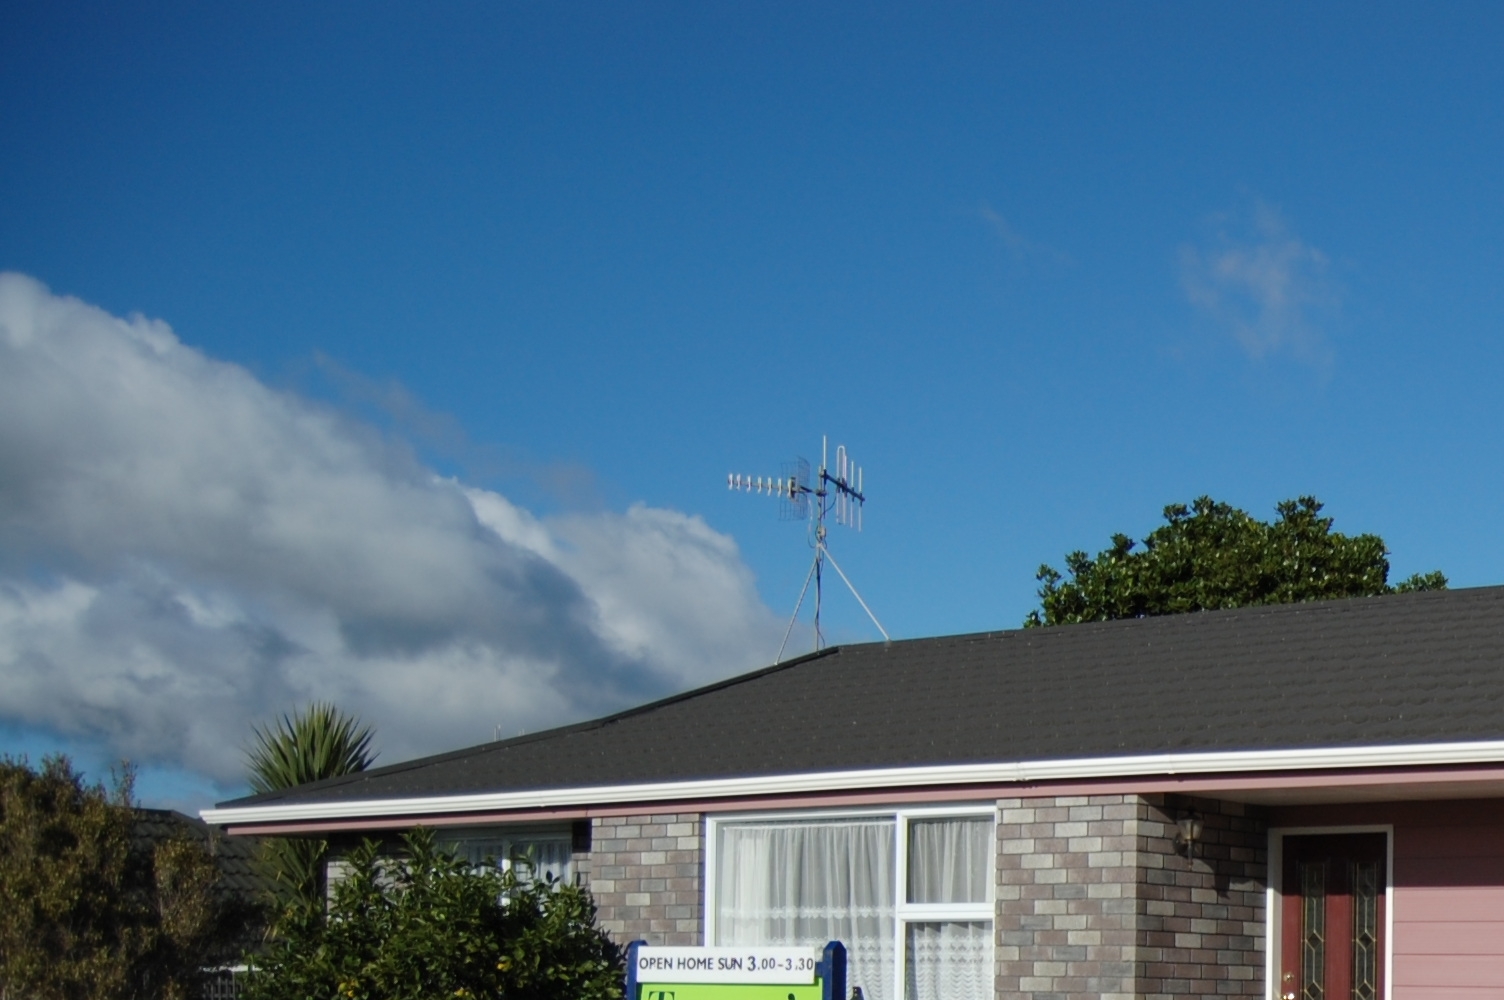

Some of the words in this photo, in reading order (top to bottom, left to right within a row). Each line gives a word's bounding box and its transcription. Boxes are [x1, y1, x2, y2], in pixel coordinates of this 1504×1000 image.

[639, 957, 673, 971] OPEN
[677, 957, 714, 971] HOME
[717, 957, 743, 971] SUN
